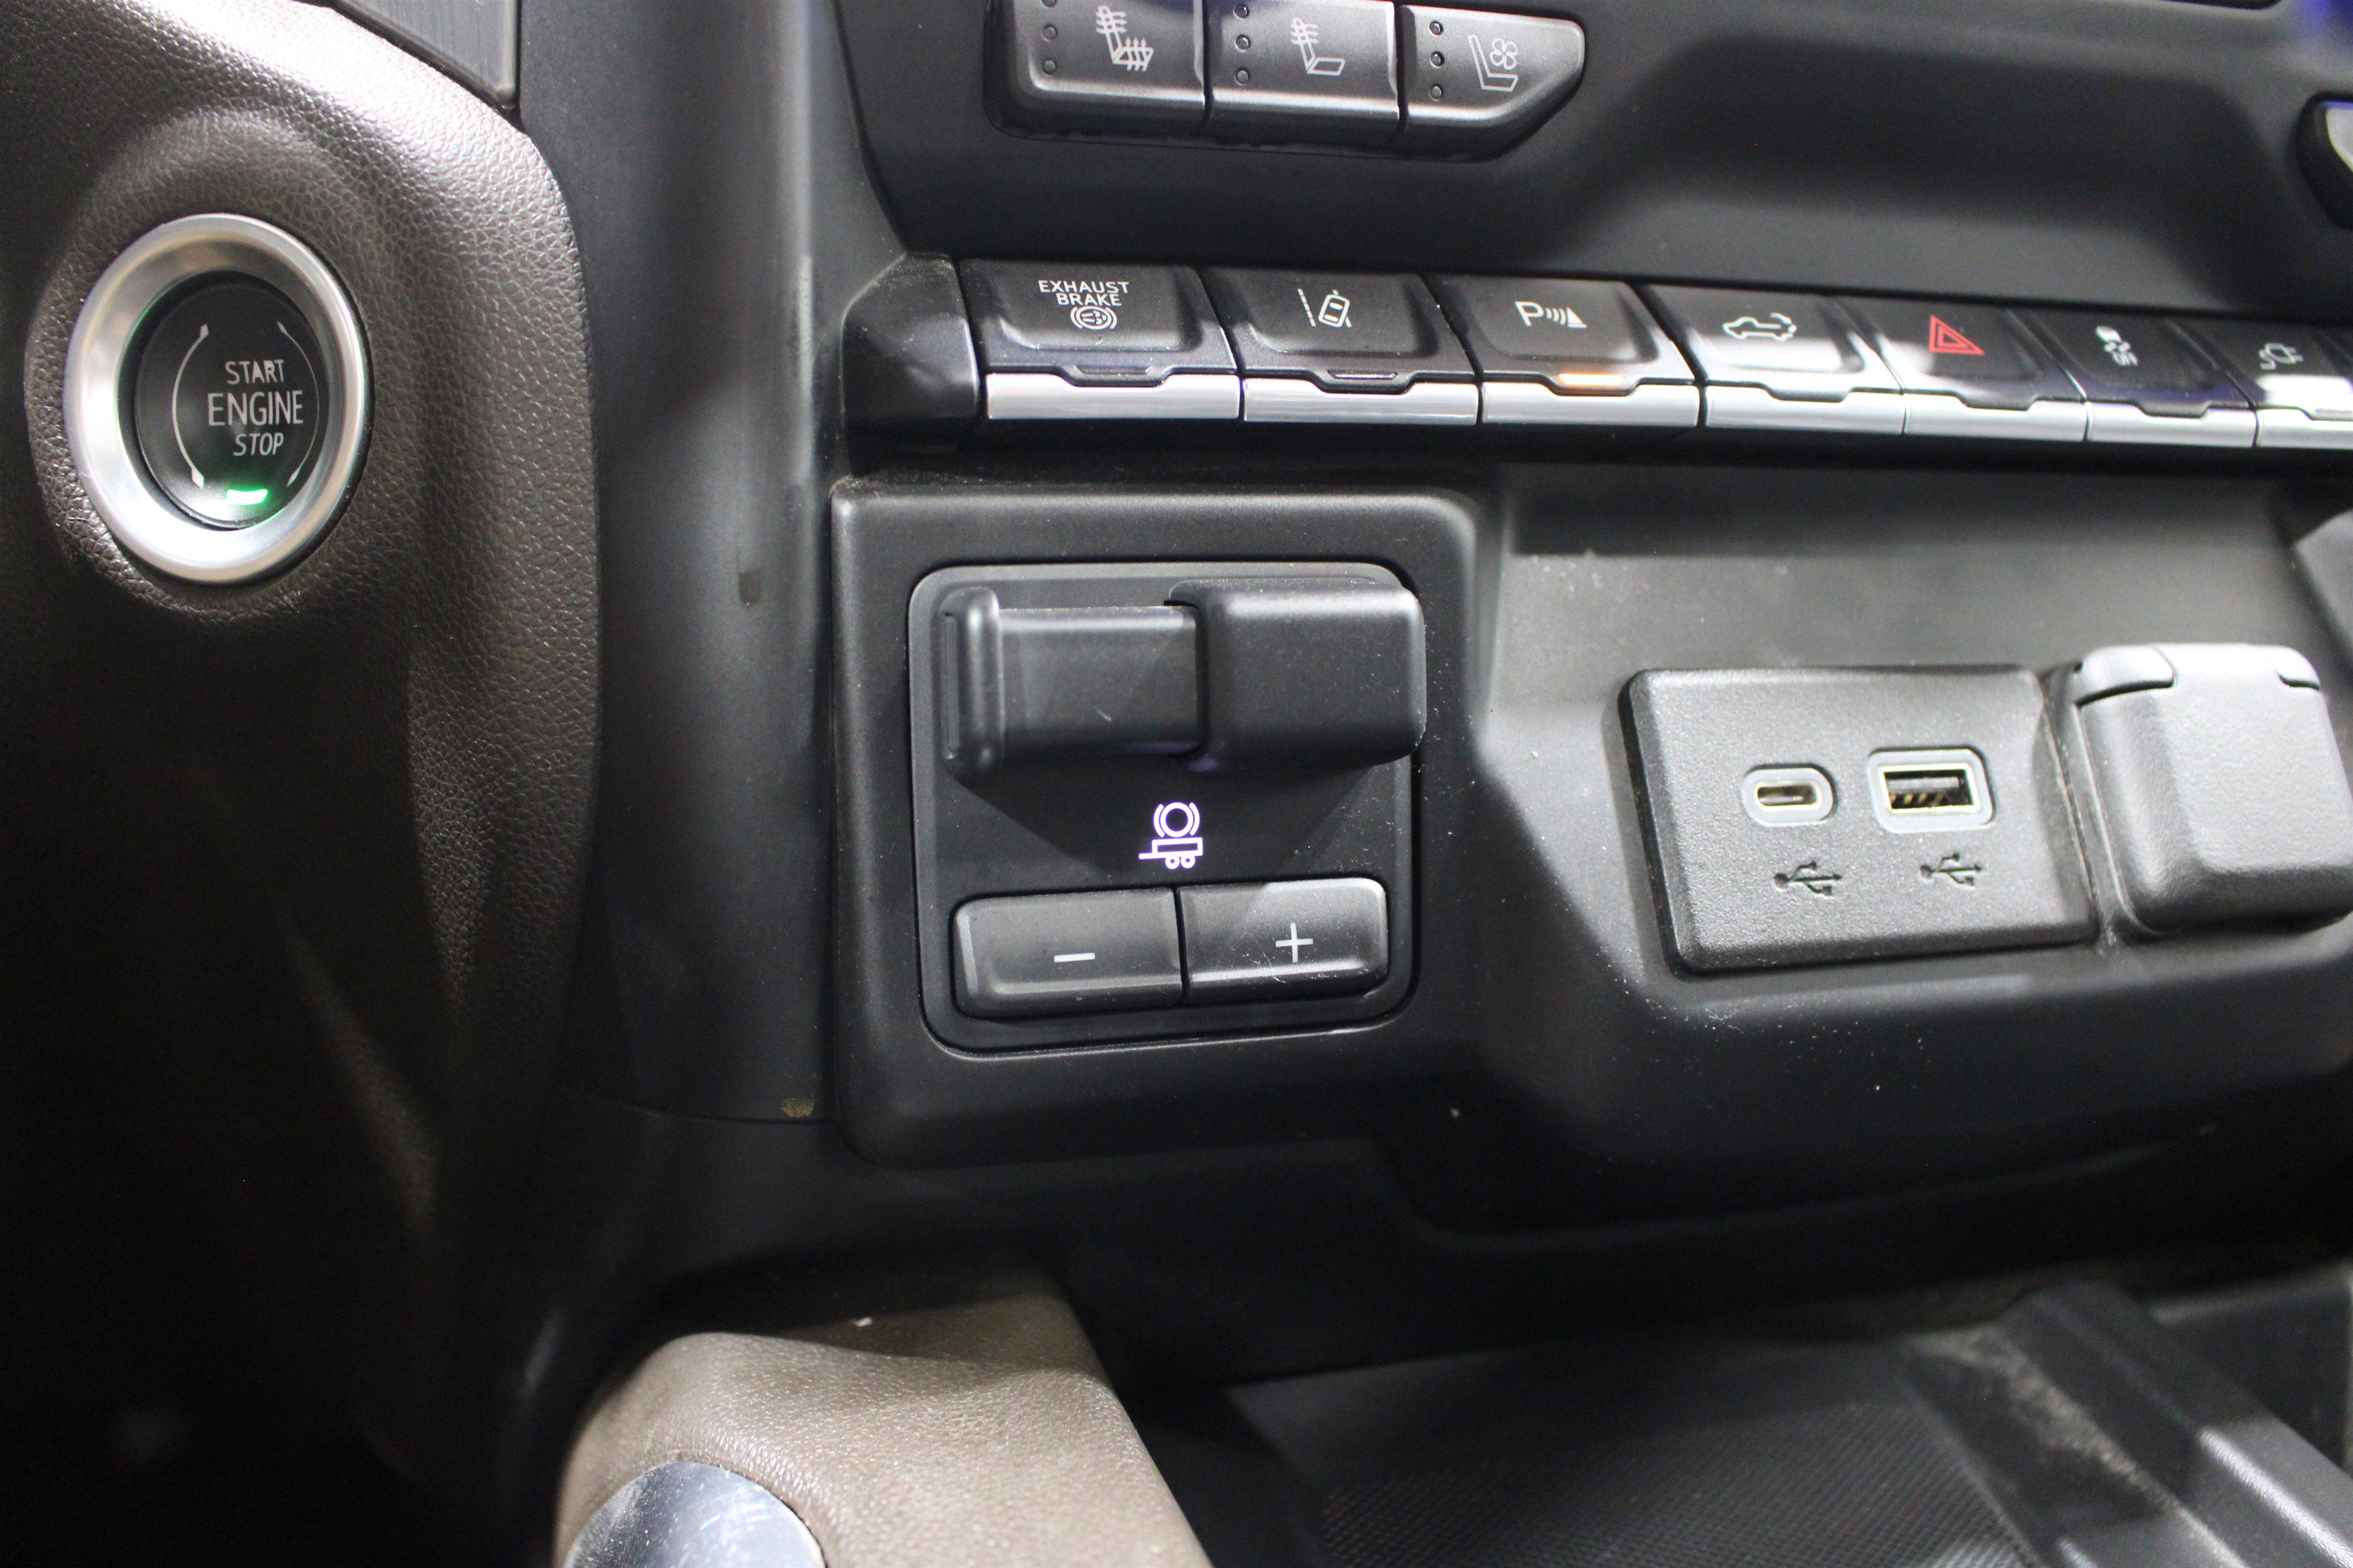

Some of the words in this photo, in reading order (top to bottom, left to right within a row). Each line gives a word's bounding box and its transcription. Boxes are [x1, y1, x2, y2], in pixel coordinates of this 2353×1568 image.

[1038, 280, 1129, 293] EXHAUST
[1056, 292, 1122, 306] BRAKE
[225, 360, 284, 384] START
[207, 390, 304, 426] ENGINE
[233, 432, 284, 457] STOP
